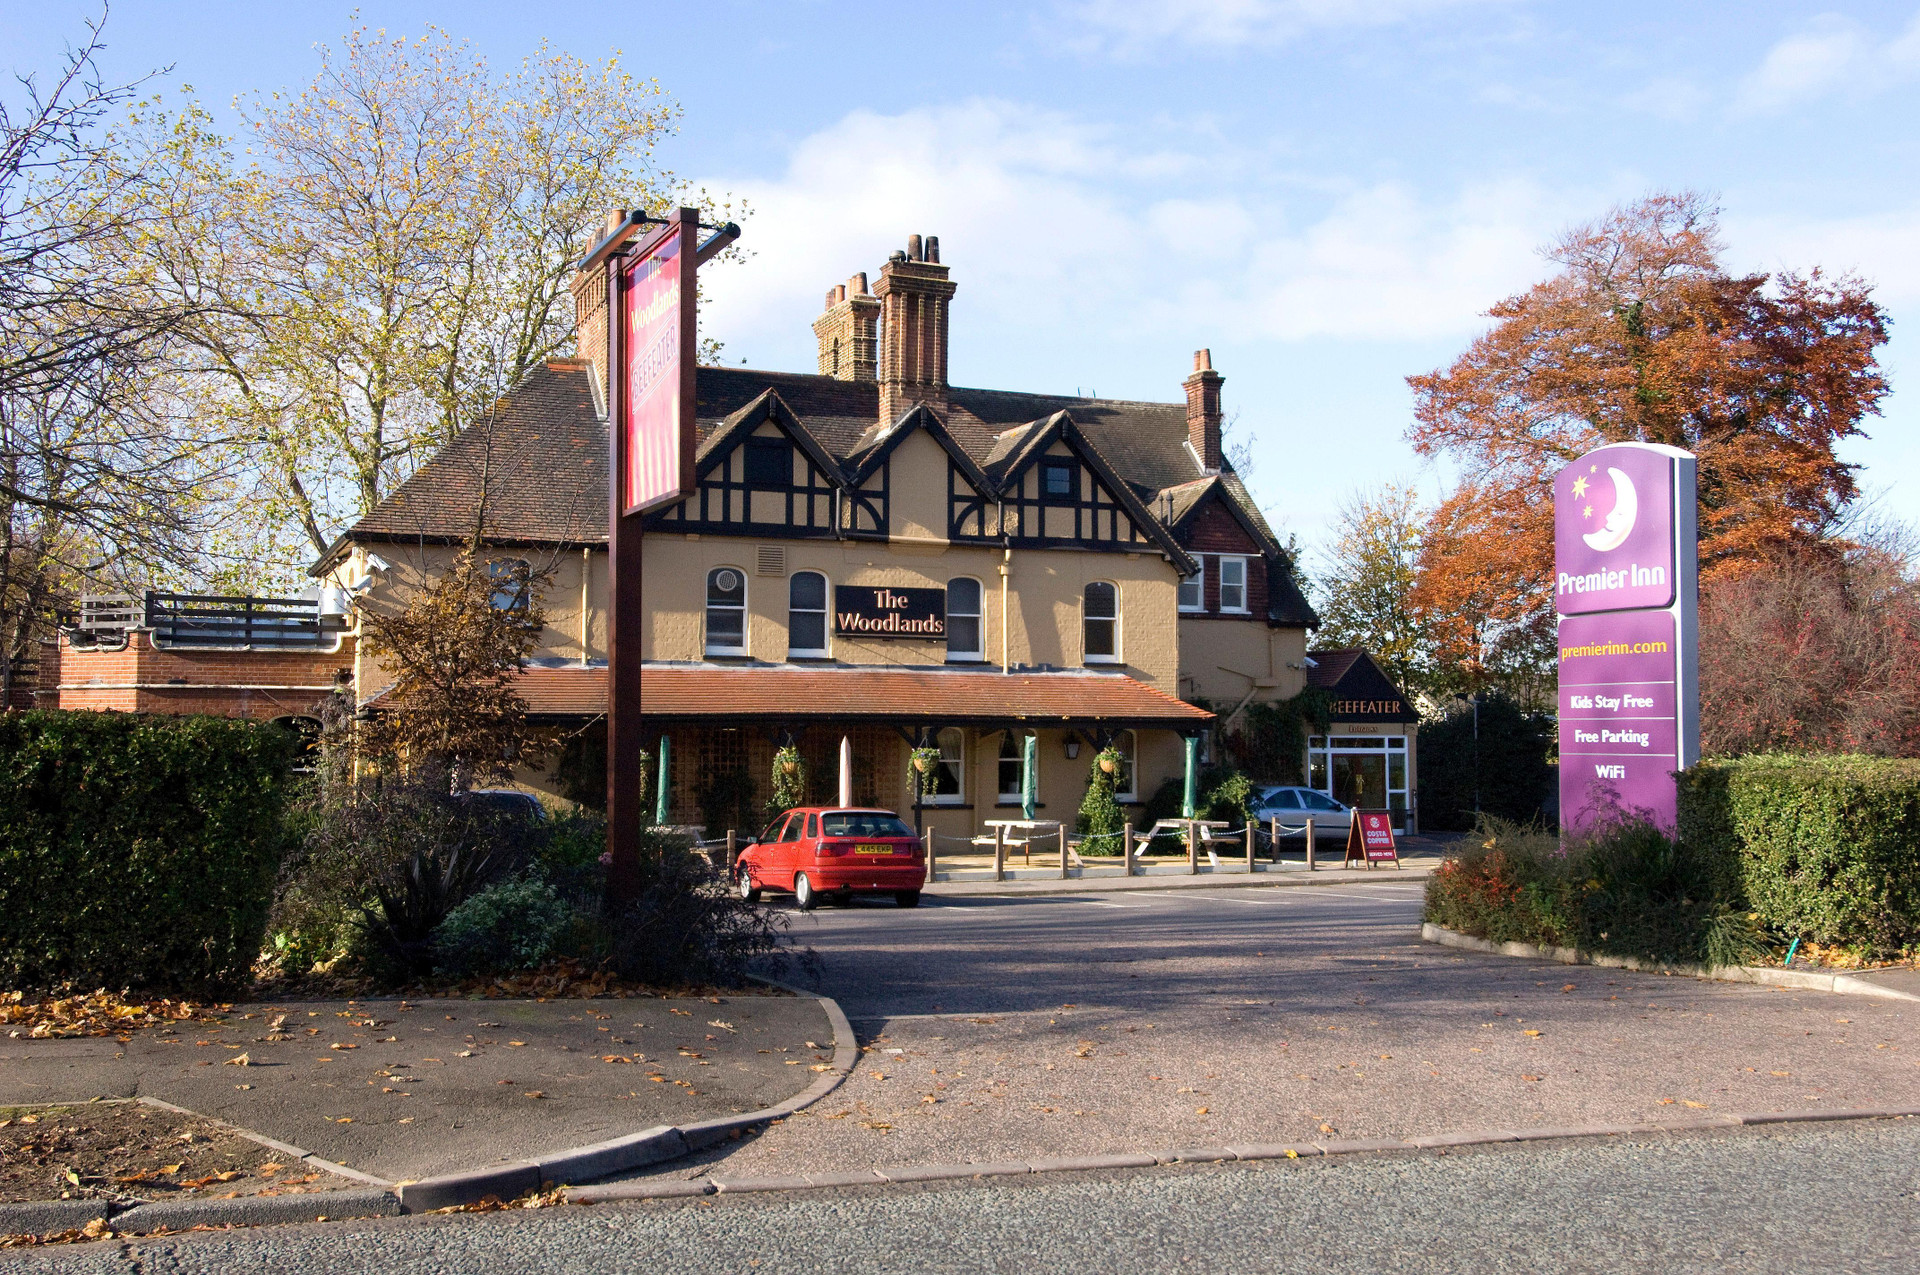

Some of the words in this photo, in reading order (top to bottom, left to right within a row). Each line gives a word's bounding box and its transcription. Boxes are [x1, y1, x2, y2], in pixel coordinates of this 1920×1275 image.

[646, 253, 662, 283] The
[630, 277, 680, 335] Woodlands
[632, 325, 677, 400] BEEFEATER
[1558, 566, 1629, 595] Premier
[1631, 563, 1665, 587] Inn
[874, 589, 909, 609] The
[837, 612, 944, 633] Woodlands
[1561, 640, 1667, 662] premierinn.com
[1570, 695, 1593, 709] Kids
[1595, 694, 1621, 712] Stay
[1623, 694, 1654, 708] Free
[1574, 729, 1599, 743] Free
[1601, 729, 1649, 747] Parking
[1595, 764, 1625, 779] WiFi
[855, 845, 875, 853] L445
